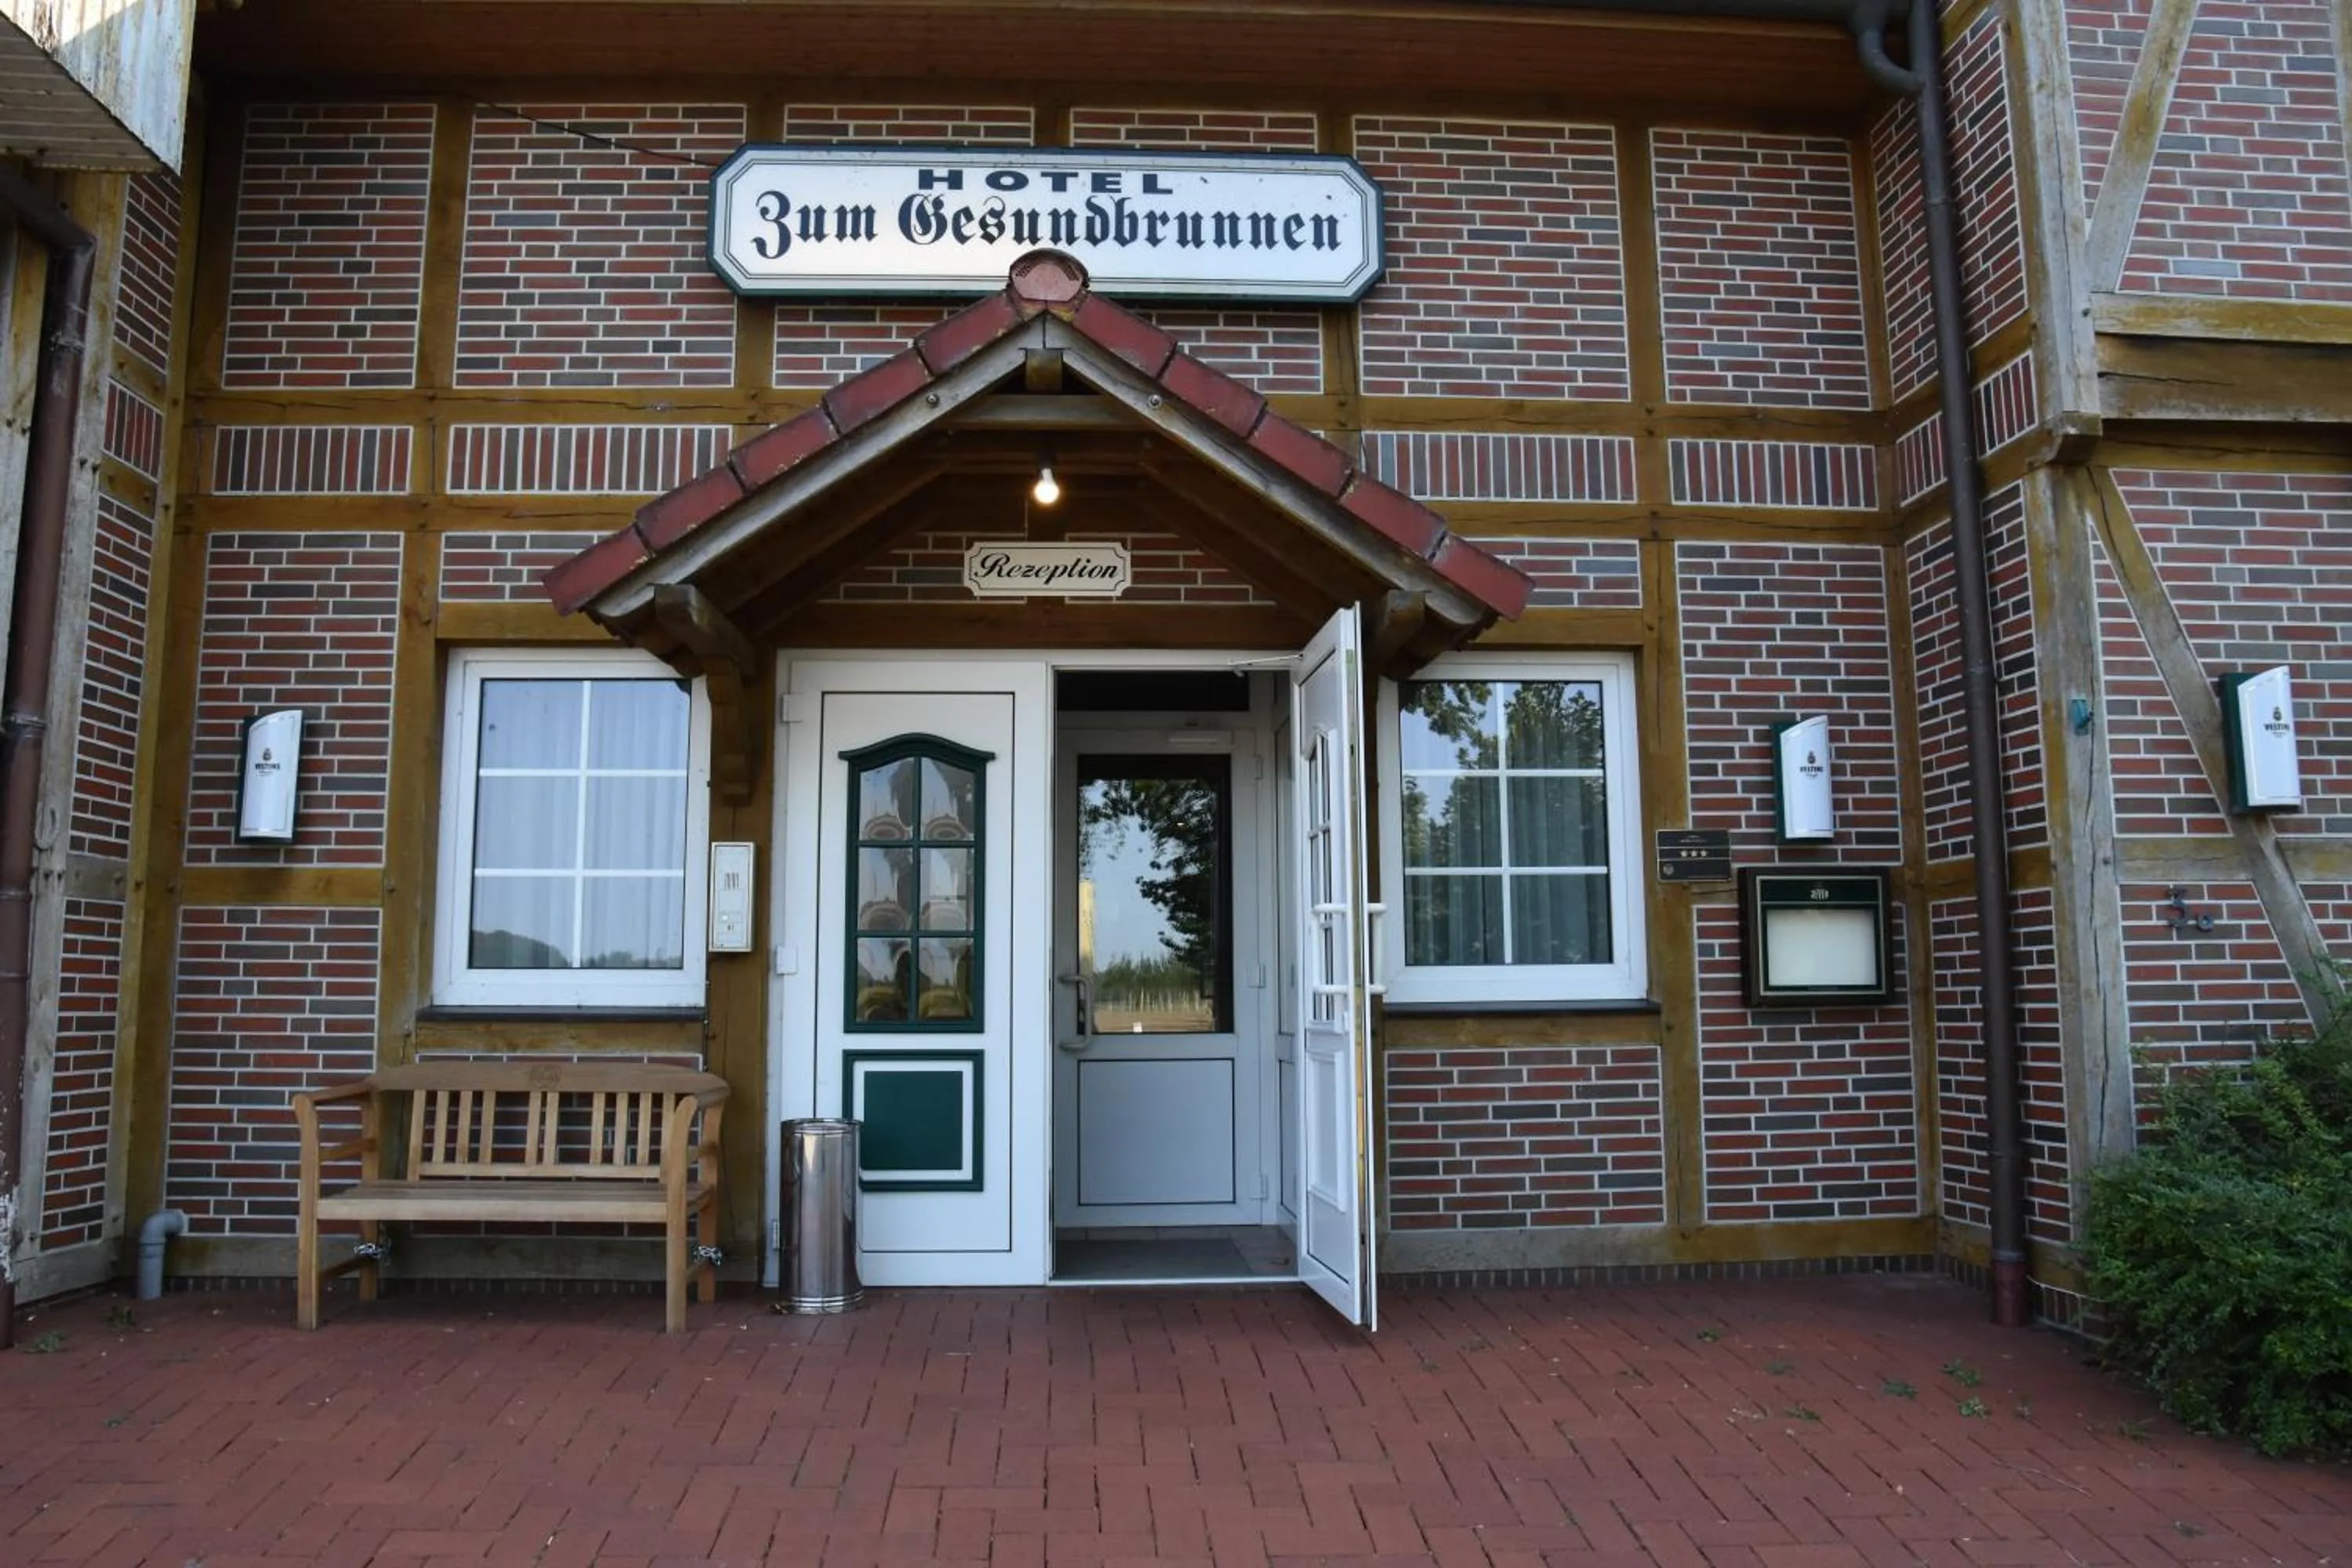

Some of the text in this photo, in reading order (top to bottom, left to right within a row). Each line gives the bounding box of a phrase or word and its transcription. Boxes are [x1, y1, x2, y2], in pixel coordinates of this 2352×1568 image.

[917, 169, 1174, 195] HOTEL
[750, 190, 1343, 260] Zum Gesundbrunnen
[974, 552, 1119, 586] Rezeption
